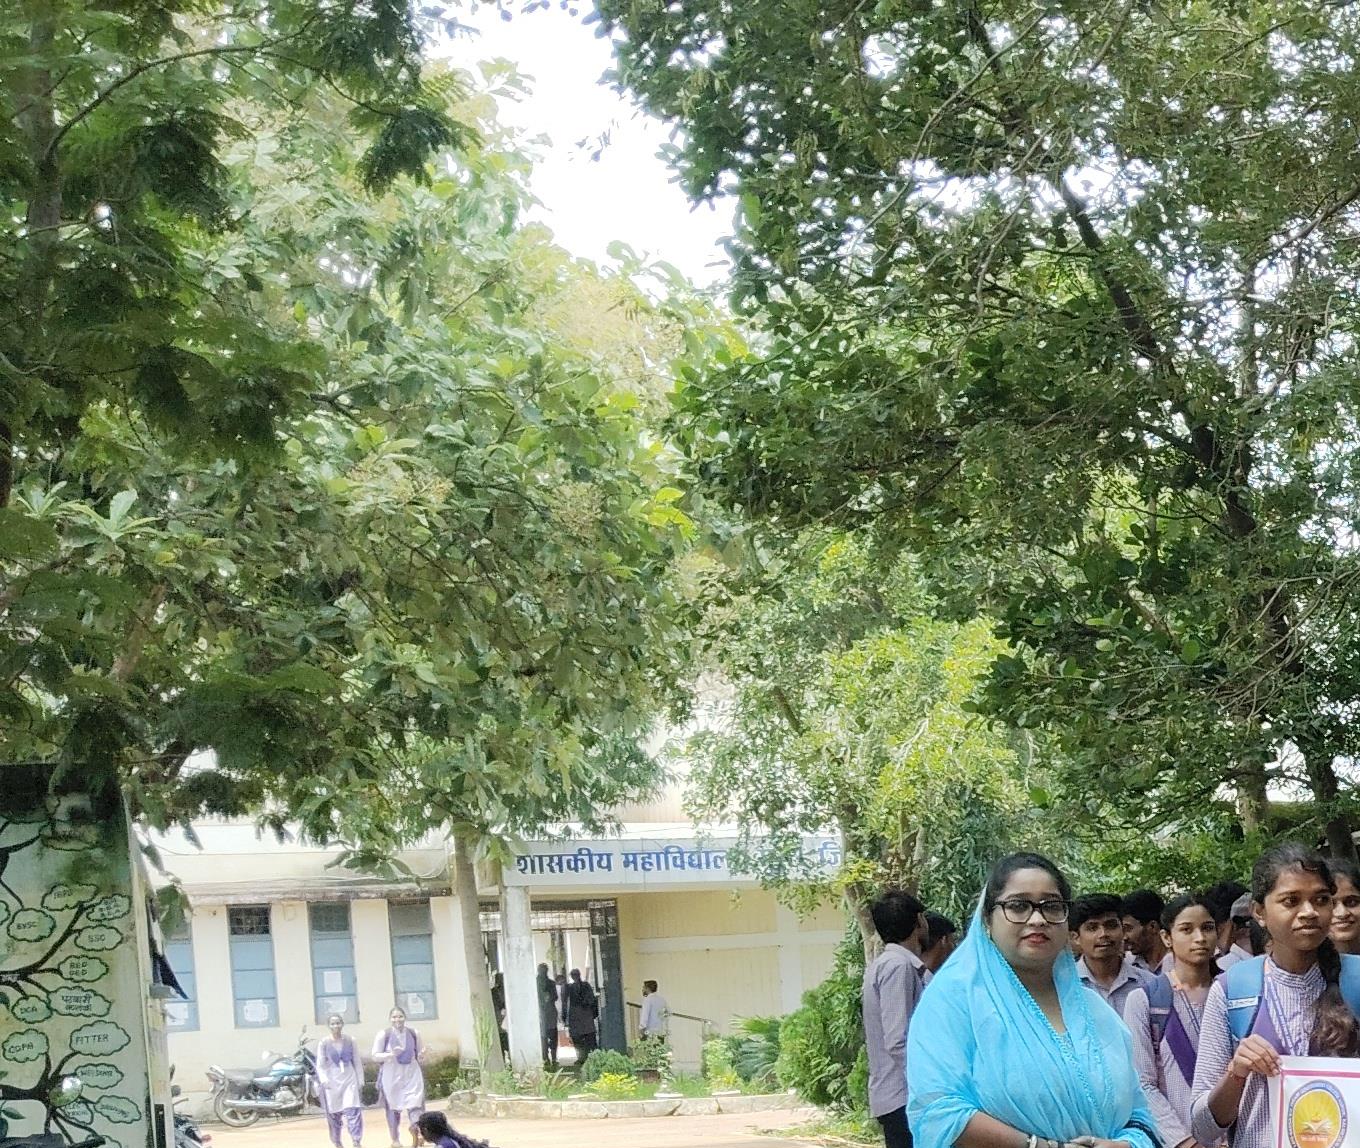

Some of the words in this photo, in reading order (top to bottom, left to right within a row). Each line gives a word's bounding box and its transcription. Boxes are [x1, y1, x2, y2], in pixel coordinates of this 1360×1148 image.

[517, 846, 613, 875] शासकीय
[621, 845, 729, 873] महाविद्याल
[76, 1034, 109, 1045] FITTER
